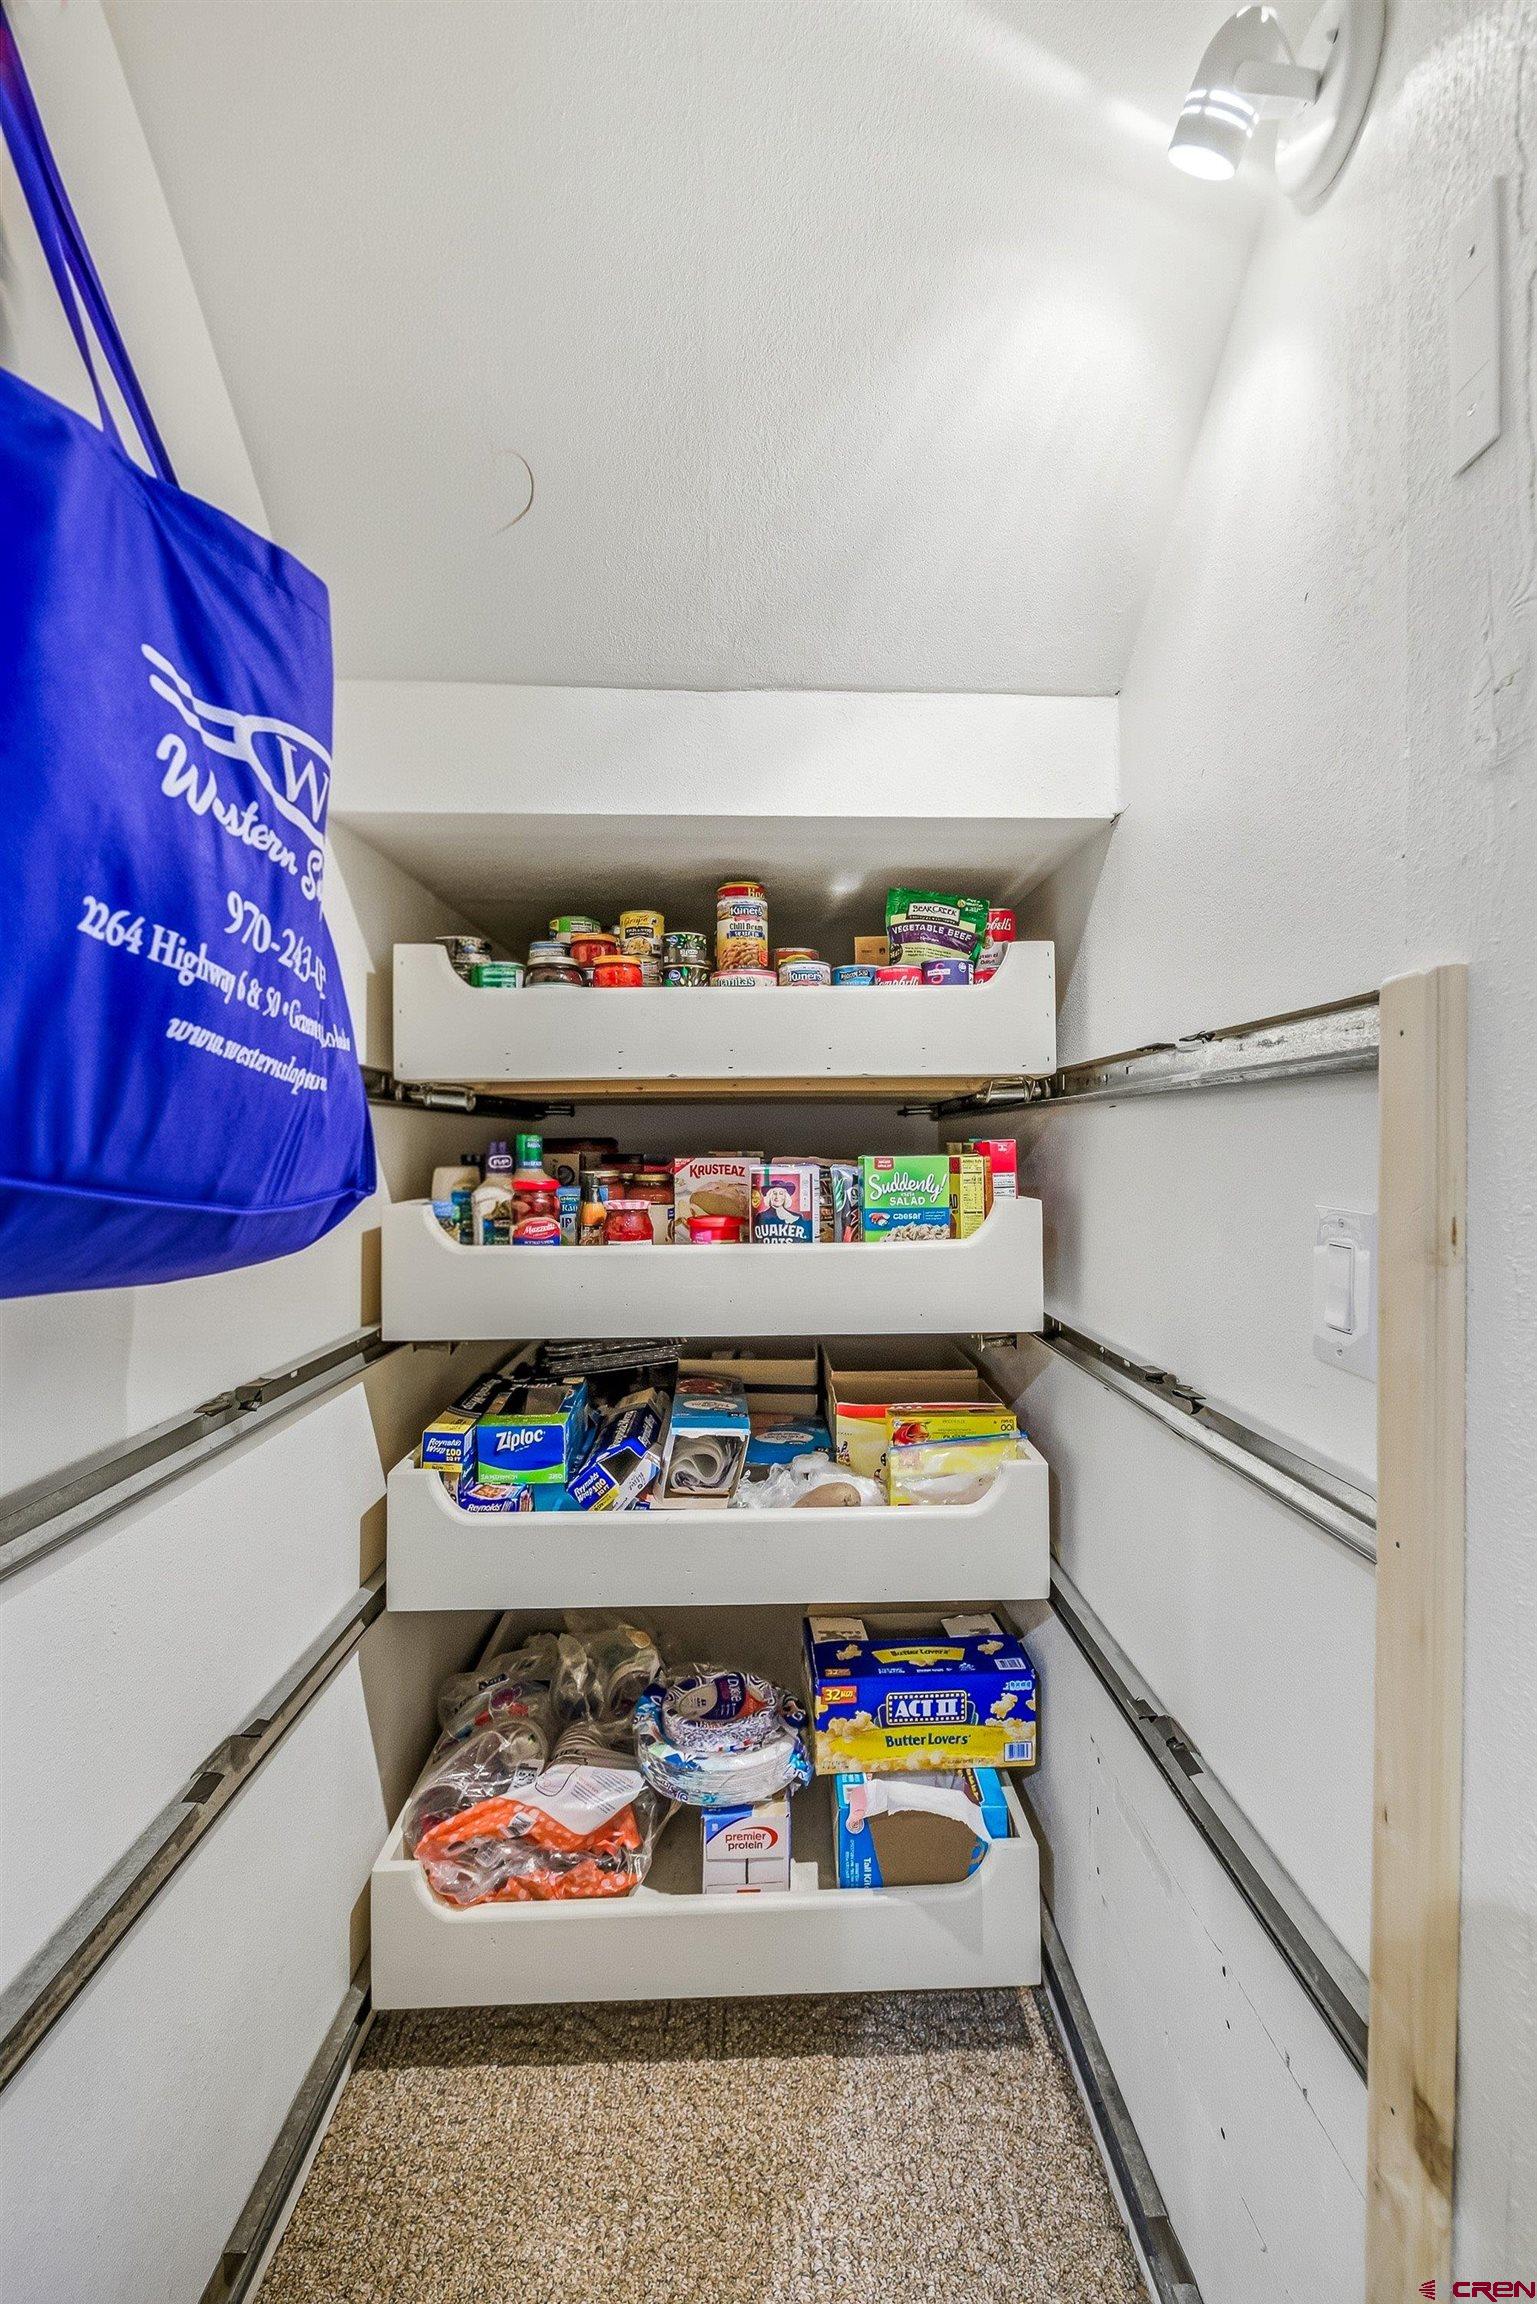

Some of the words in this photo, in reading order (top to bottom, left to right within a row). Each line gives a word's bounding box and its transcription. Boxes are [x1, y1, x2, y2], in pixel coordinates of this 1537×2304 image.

[156, 733, 298, 876] Western
[891, 924, 944, 935] VEGETABLE
[947, 929, 972, 941] BEEF
[77, 895, 146, 955] 2264
[147, 923, 236, 1004] Highway
[689, 1164, 746, 1178] KRUSTEAZ
[868, 1172, 948, 1203] Suddenly!
[889, 1196, 926, 1206] SALAD
[892, 1212, 922, 1220] caesar
[754, 1223, 804, 1239] QUAKER
[428, 1437, 462, 1447] Reynolds
[496, 1428, 544, 1452] Ziploc
[467, 1503, 502, 1512] Reynolds
[824, 1690, 841, 1702] 32
[895, 1701, 932, 1718] ACT
[937, 1699, 959, 1716] II
[885, 1734, 926, 1747] Butter
[725, 1832, 767, 1843] premier
[727, 1841, 763, 1852] protein
